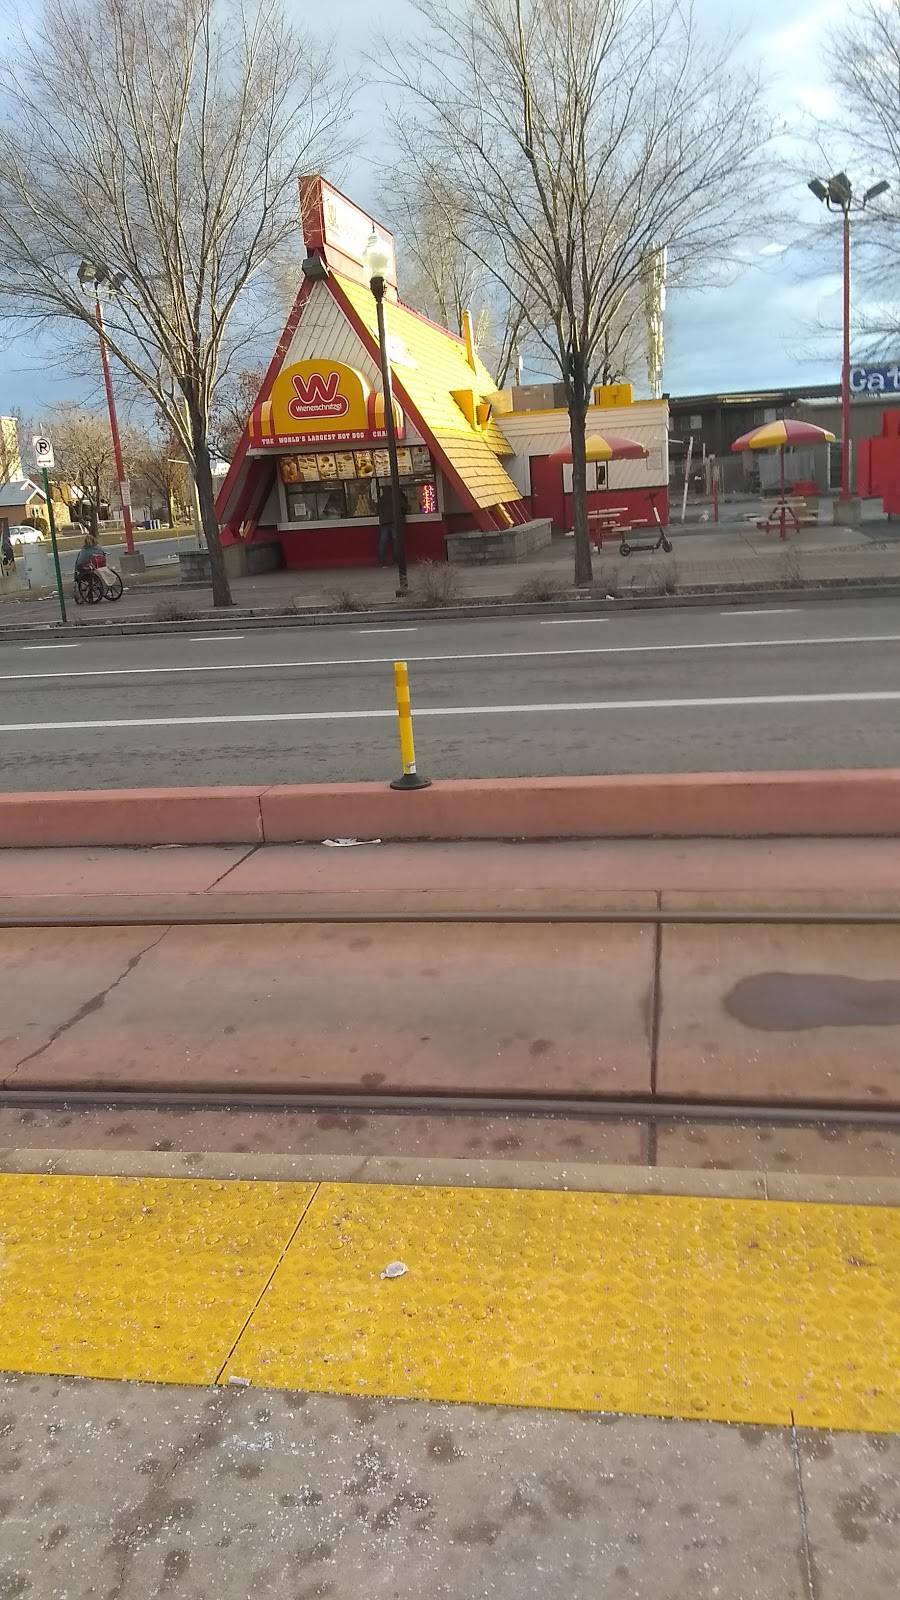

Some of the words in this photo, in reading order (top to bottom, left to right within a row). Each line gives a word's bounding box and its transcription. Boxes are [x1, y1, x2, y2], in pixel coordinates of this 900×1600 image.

[292, 372, 340, 404] W
[279, 435, 306, 443] WORLD'S
[307, 433, 336, 441] LARGEST
